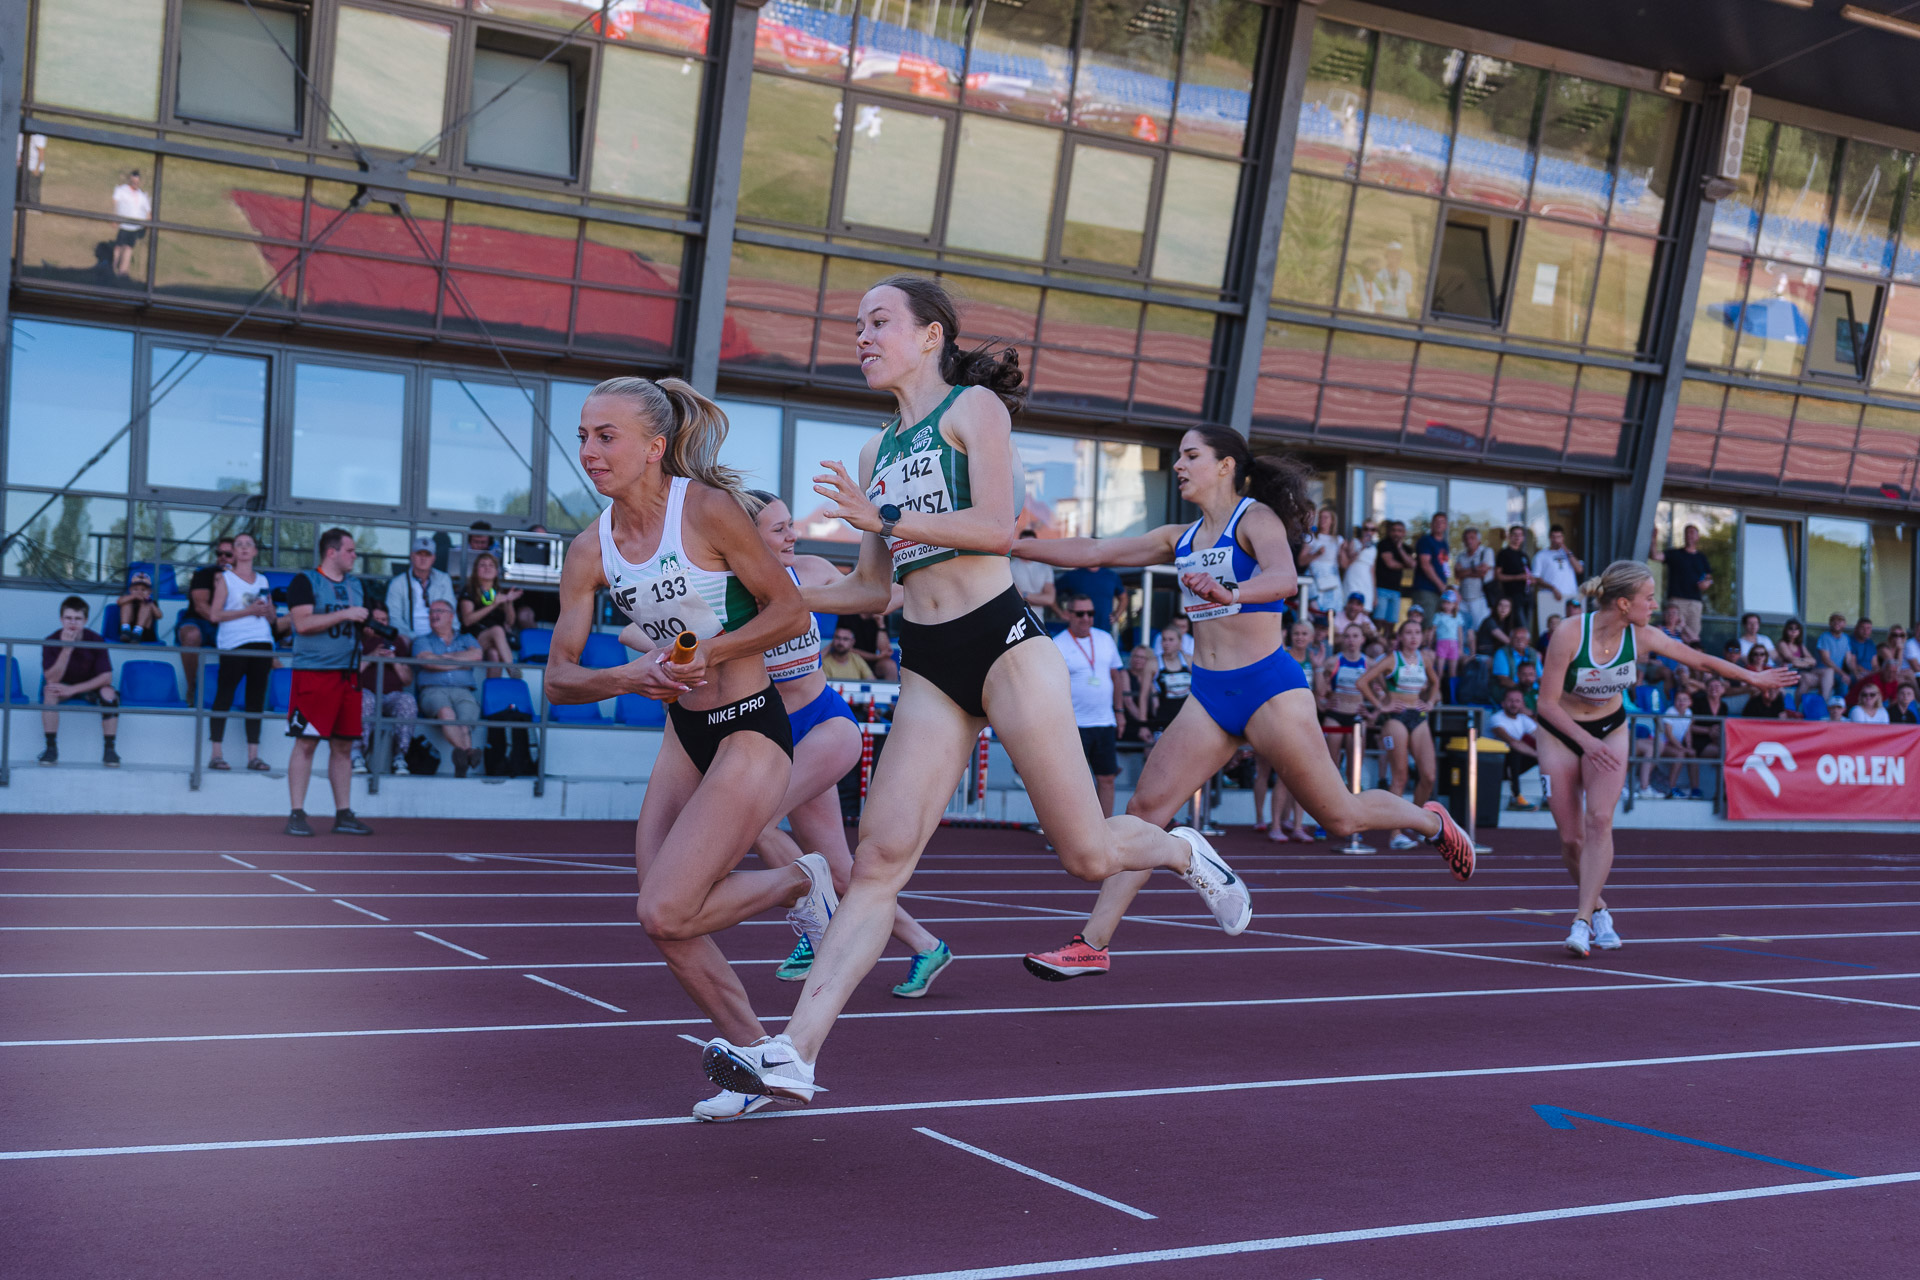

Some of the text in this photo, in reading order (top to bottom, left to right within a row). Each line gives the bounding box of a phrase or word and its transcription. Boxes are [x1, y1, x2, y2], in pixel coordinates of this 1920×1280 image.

[902, 456, 933, 484] 142
[1202, 551, 1226, 567] 329
[651, 576, 687, 603] 133
[1214, 608, 1229, 616] 2025
[796, 664, 815, 674] 2025
[1616, 666, 1629, 676] 48
[708, 695, 766, 725] NIKE PRO
[1816, 753, 1906, 786] ORLEN
[1078, 954, 1107, 962] balance
